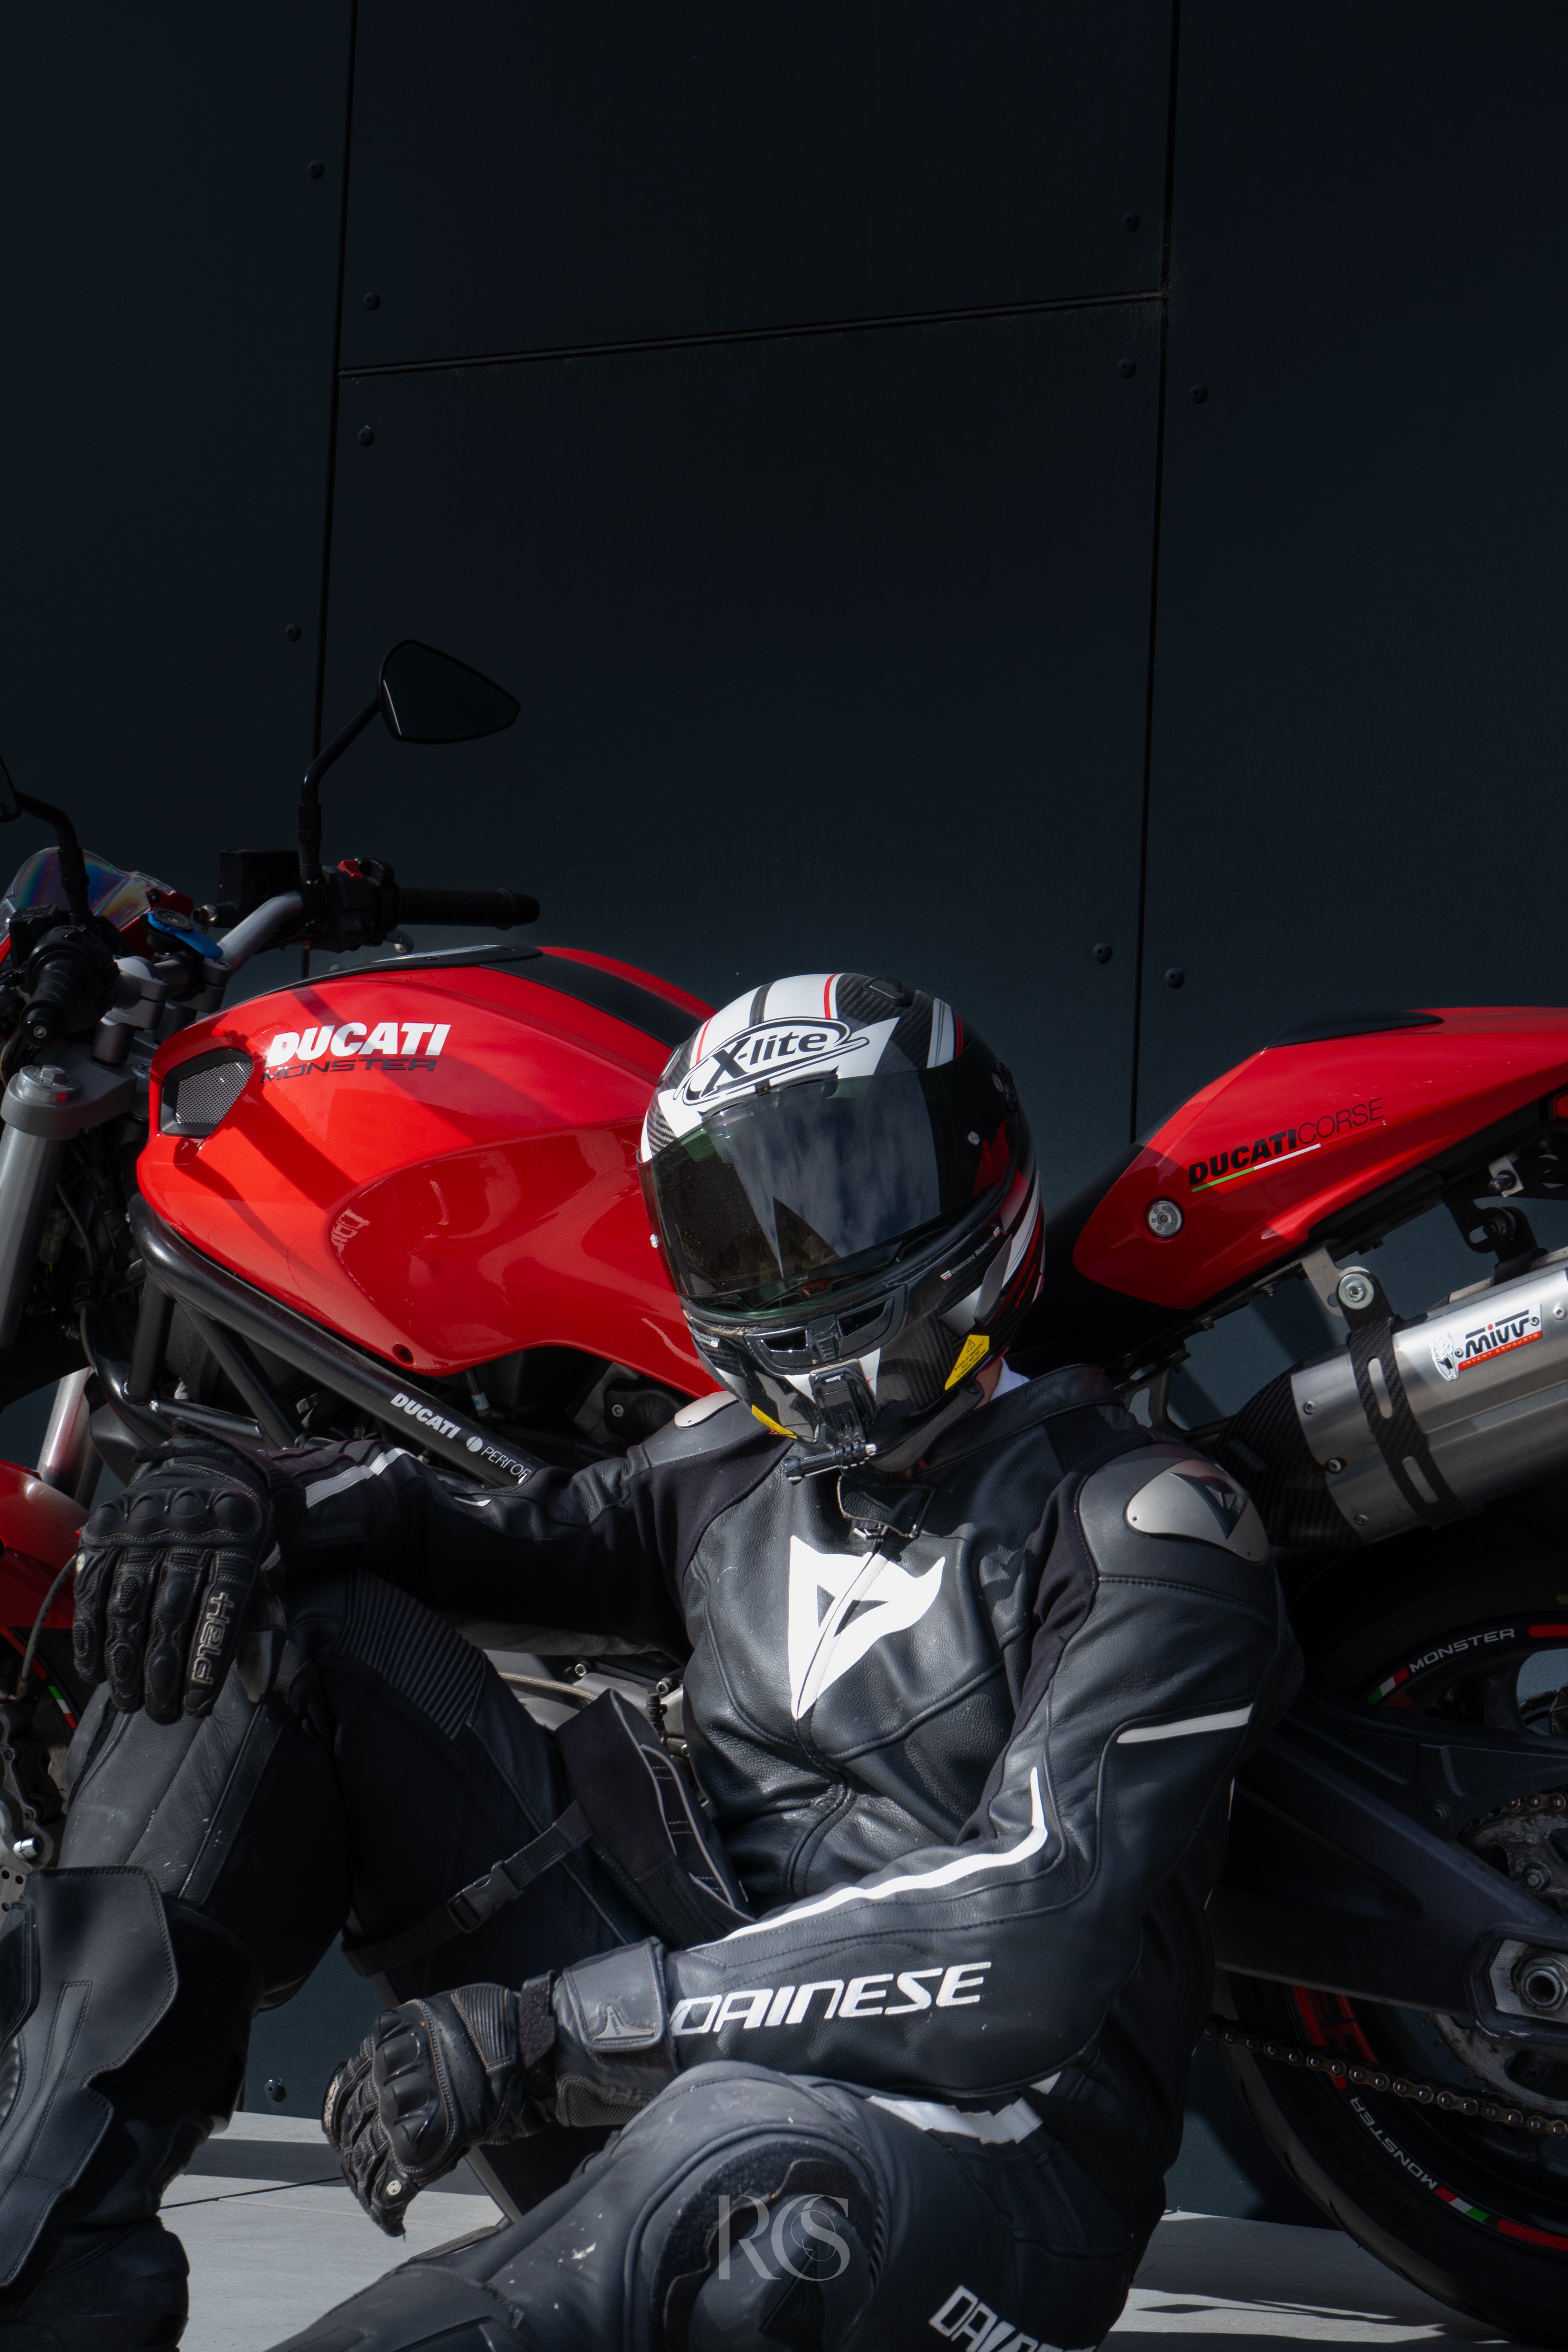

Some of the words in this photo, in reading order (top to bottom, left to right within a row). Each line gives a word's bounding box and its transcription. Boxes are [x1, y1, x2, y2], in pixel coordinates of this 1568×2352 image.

[261, 1058, 437, 1083] MONSTER
[265, 1022, 451, 1068] DUCATI
[701, 1031, 828, 1098] X-lite
[1188, 1128, 1297, 1186] DUCATI
[1298, 1098, 1385, 1145] CORSE
[390, 1393, 461, 1439] DUCATI
[1409, 1628, 1515, 1674] MONSTER
[670, 1962, 992, 2036] DAINESE
[1350, 2097, 1438, 2190] MONSTER
